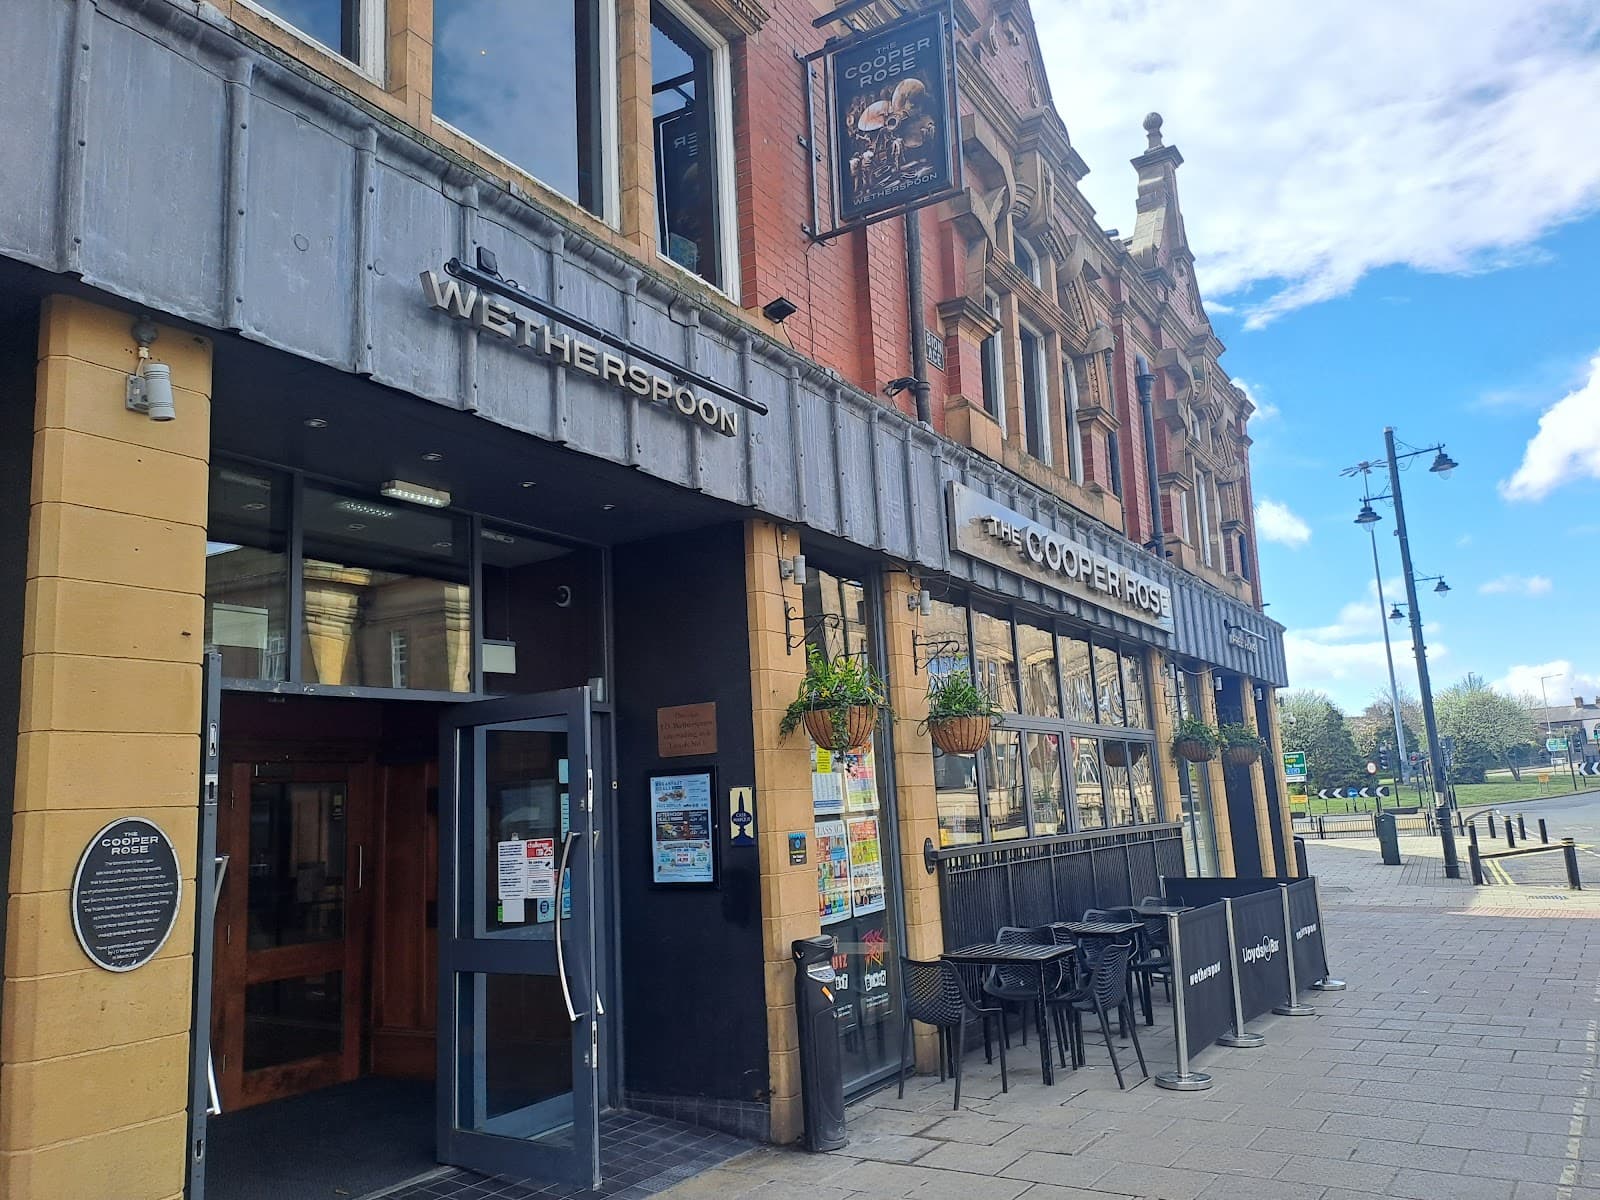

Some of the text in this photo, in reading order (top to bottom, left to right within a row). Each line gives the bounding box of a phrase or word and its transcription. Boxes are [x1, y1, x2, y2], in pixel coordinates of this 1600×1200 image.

[844, 37, 931, 80] COOPER
[877, 41, 897, 54] THE
[859, 57, 916, 88] ROSE
[853, 172, 937, 206] WETHERSPOON
[419, 270, 738, 437] WETHERSPOON
[984, 515, 1171, 618] THE COOPER ROSE
[101, 836, 159, 847] COOPER
[111, 845, 149, 855] ROSE
[832, 953, 848, 970] UIZ
